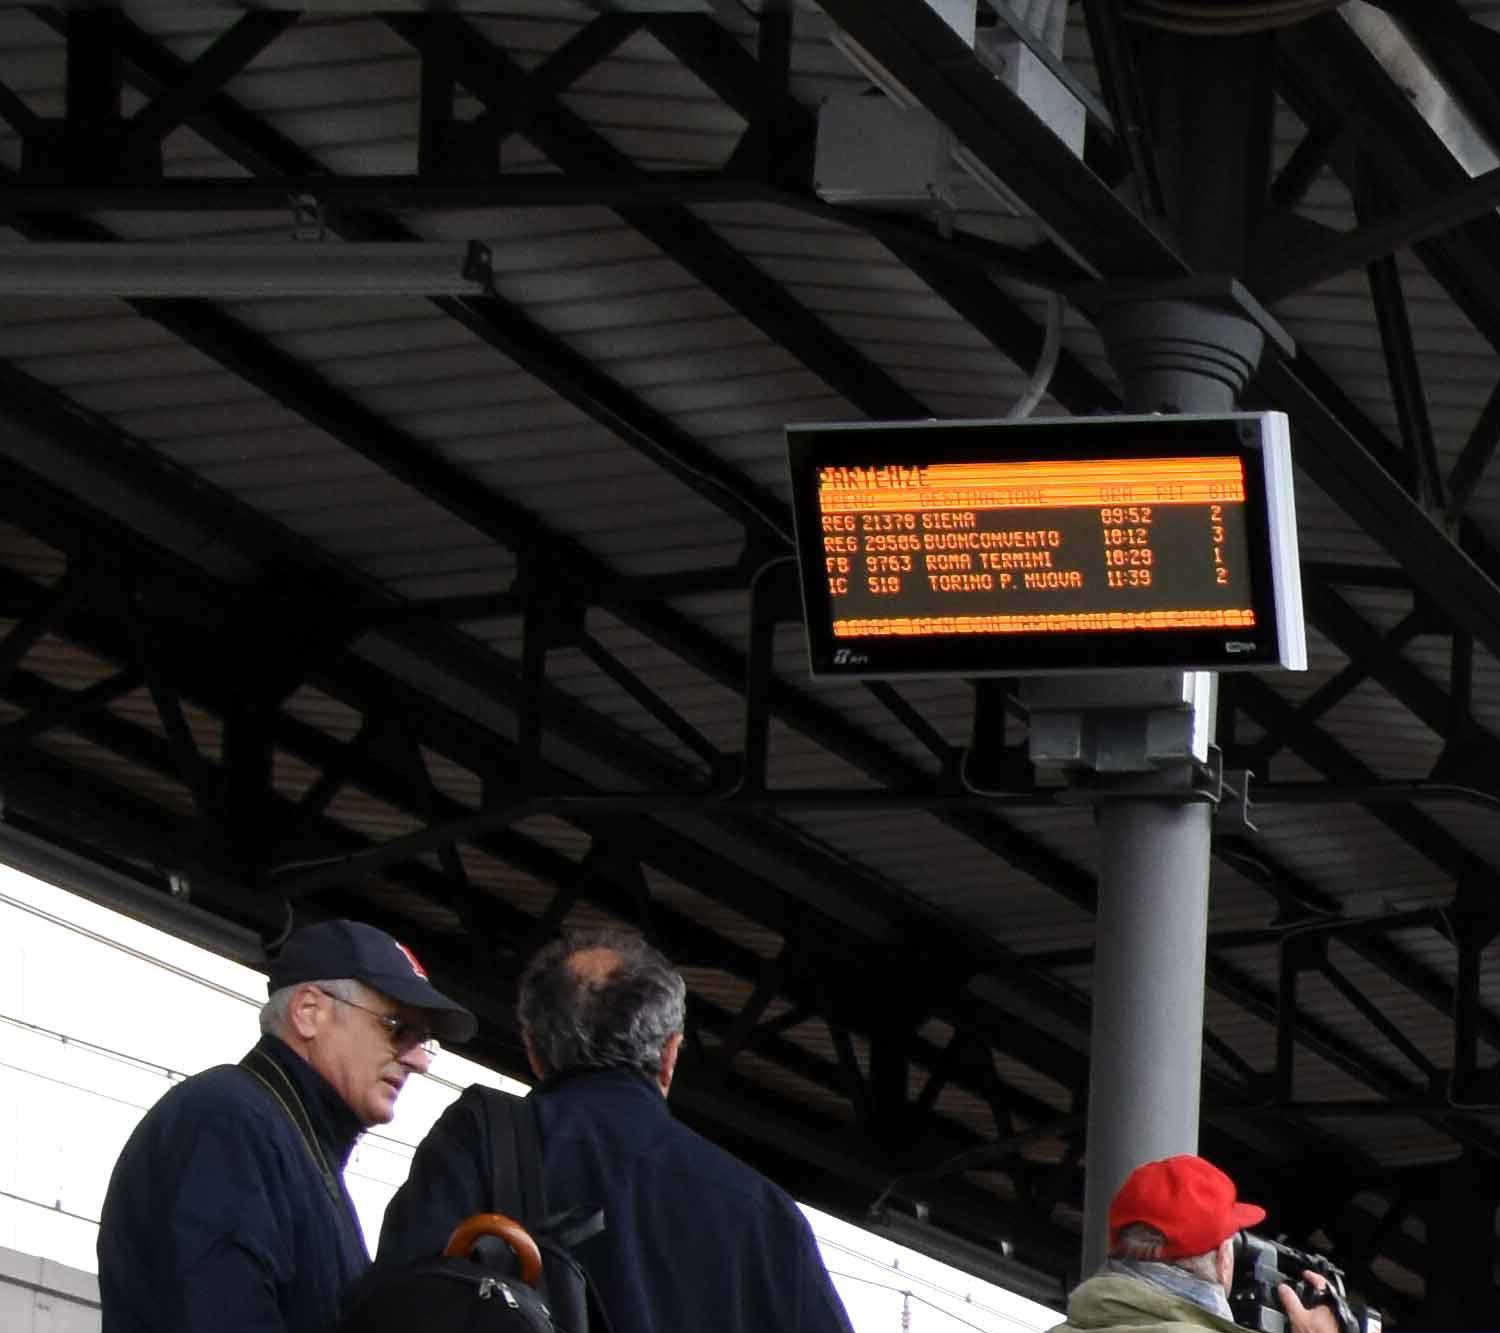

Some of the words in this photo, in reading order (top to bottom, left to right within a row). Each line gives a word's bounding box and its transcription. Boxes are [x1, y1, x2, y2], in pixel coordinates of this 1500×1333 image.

[822, 515, 855, 531] REG
[921, 512, 975, 529] SIENA
[1210, 505, 1223, 521] 2
[824, 535, 857, 552] REG
[923, 531, 1061, 549] BUONCONVENTO
[1212, 526, 1224, 542] 3
[926, 553, 971, 571] ROMA
[979, 551, 1053, 569] TERMINI
[1212, 547, 1223, 563] 1
[828, 577, 848, 594] IC
[928, 573, 993, 592] TORINO
[1000, 574, 1019, 592] P.
[1023, 571, 1083, 589] NUOVA
[1106, 569, 1152, 587] 11:39
[1215, 567, 1229, 584] 2
